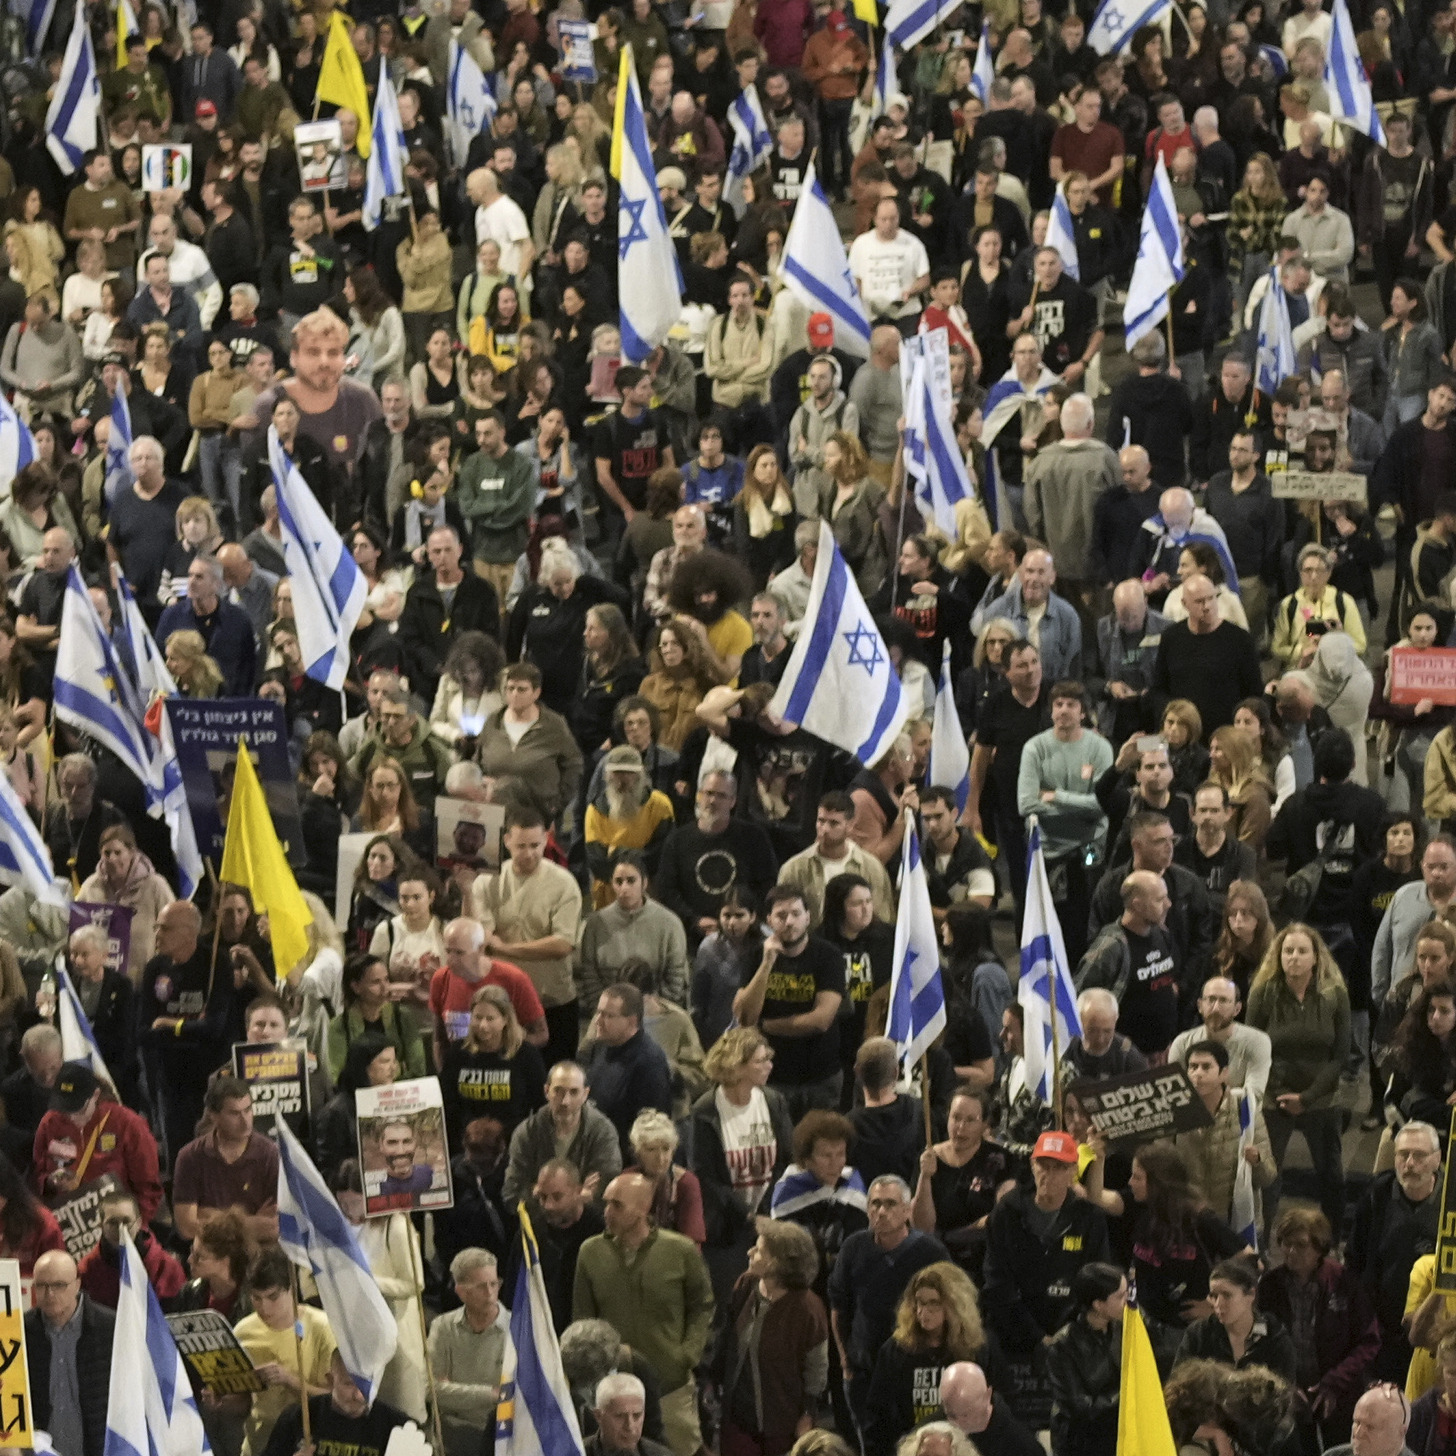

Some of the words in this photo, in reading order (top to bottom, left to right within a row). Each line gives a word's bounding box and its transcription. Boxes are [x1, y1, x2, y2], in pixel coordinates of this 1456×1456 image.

[203, 710, 249, 727] ניצחון
[252, 709, 274, 724] אין
[1101, 1083, 1156, 1110] שלום
[1158, 1075, 1186, 1097] רק
[1150, 1090, 1193, 1114] יביא
[1092, 1098, 1155, 1132] ביטחון
[66, 1229, 103, 1254] STOP
[913, 1367, 938, 1387] GET
